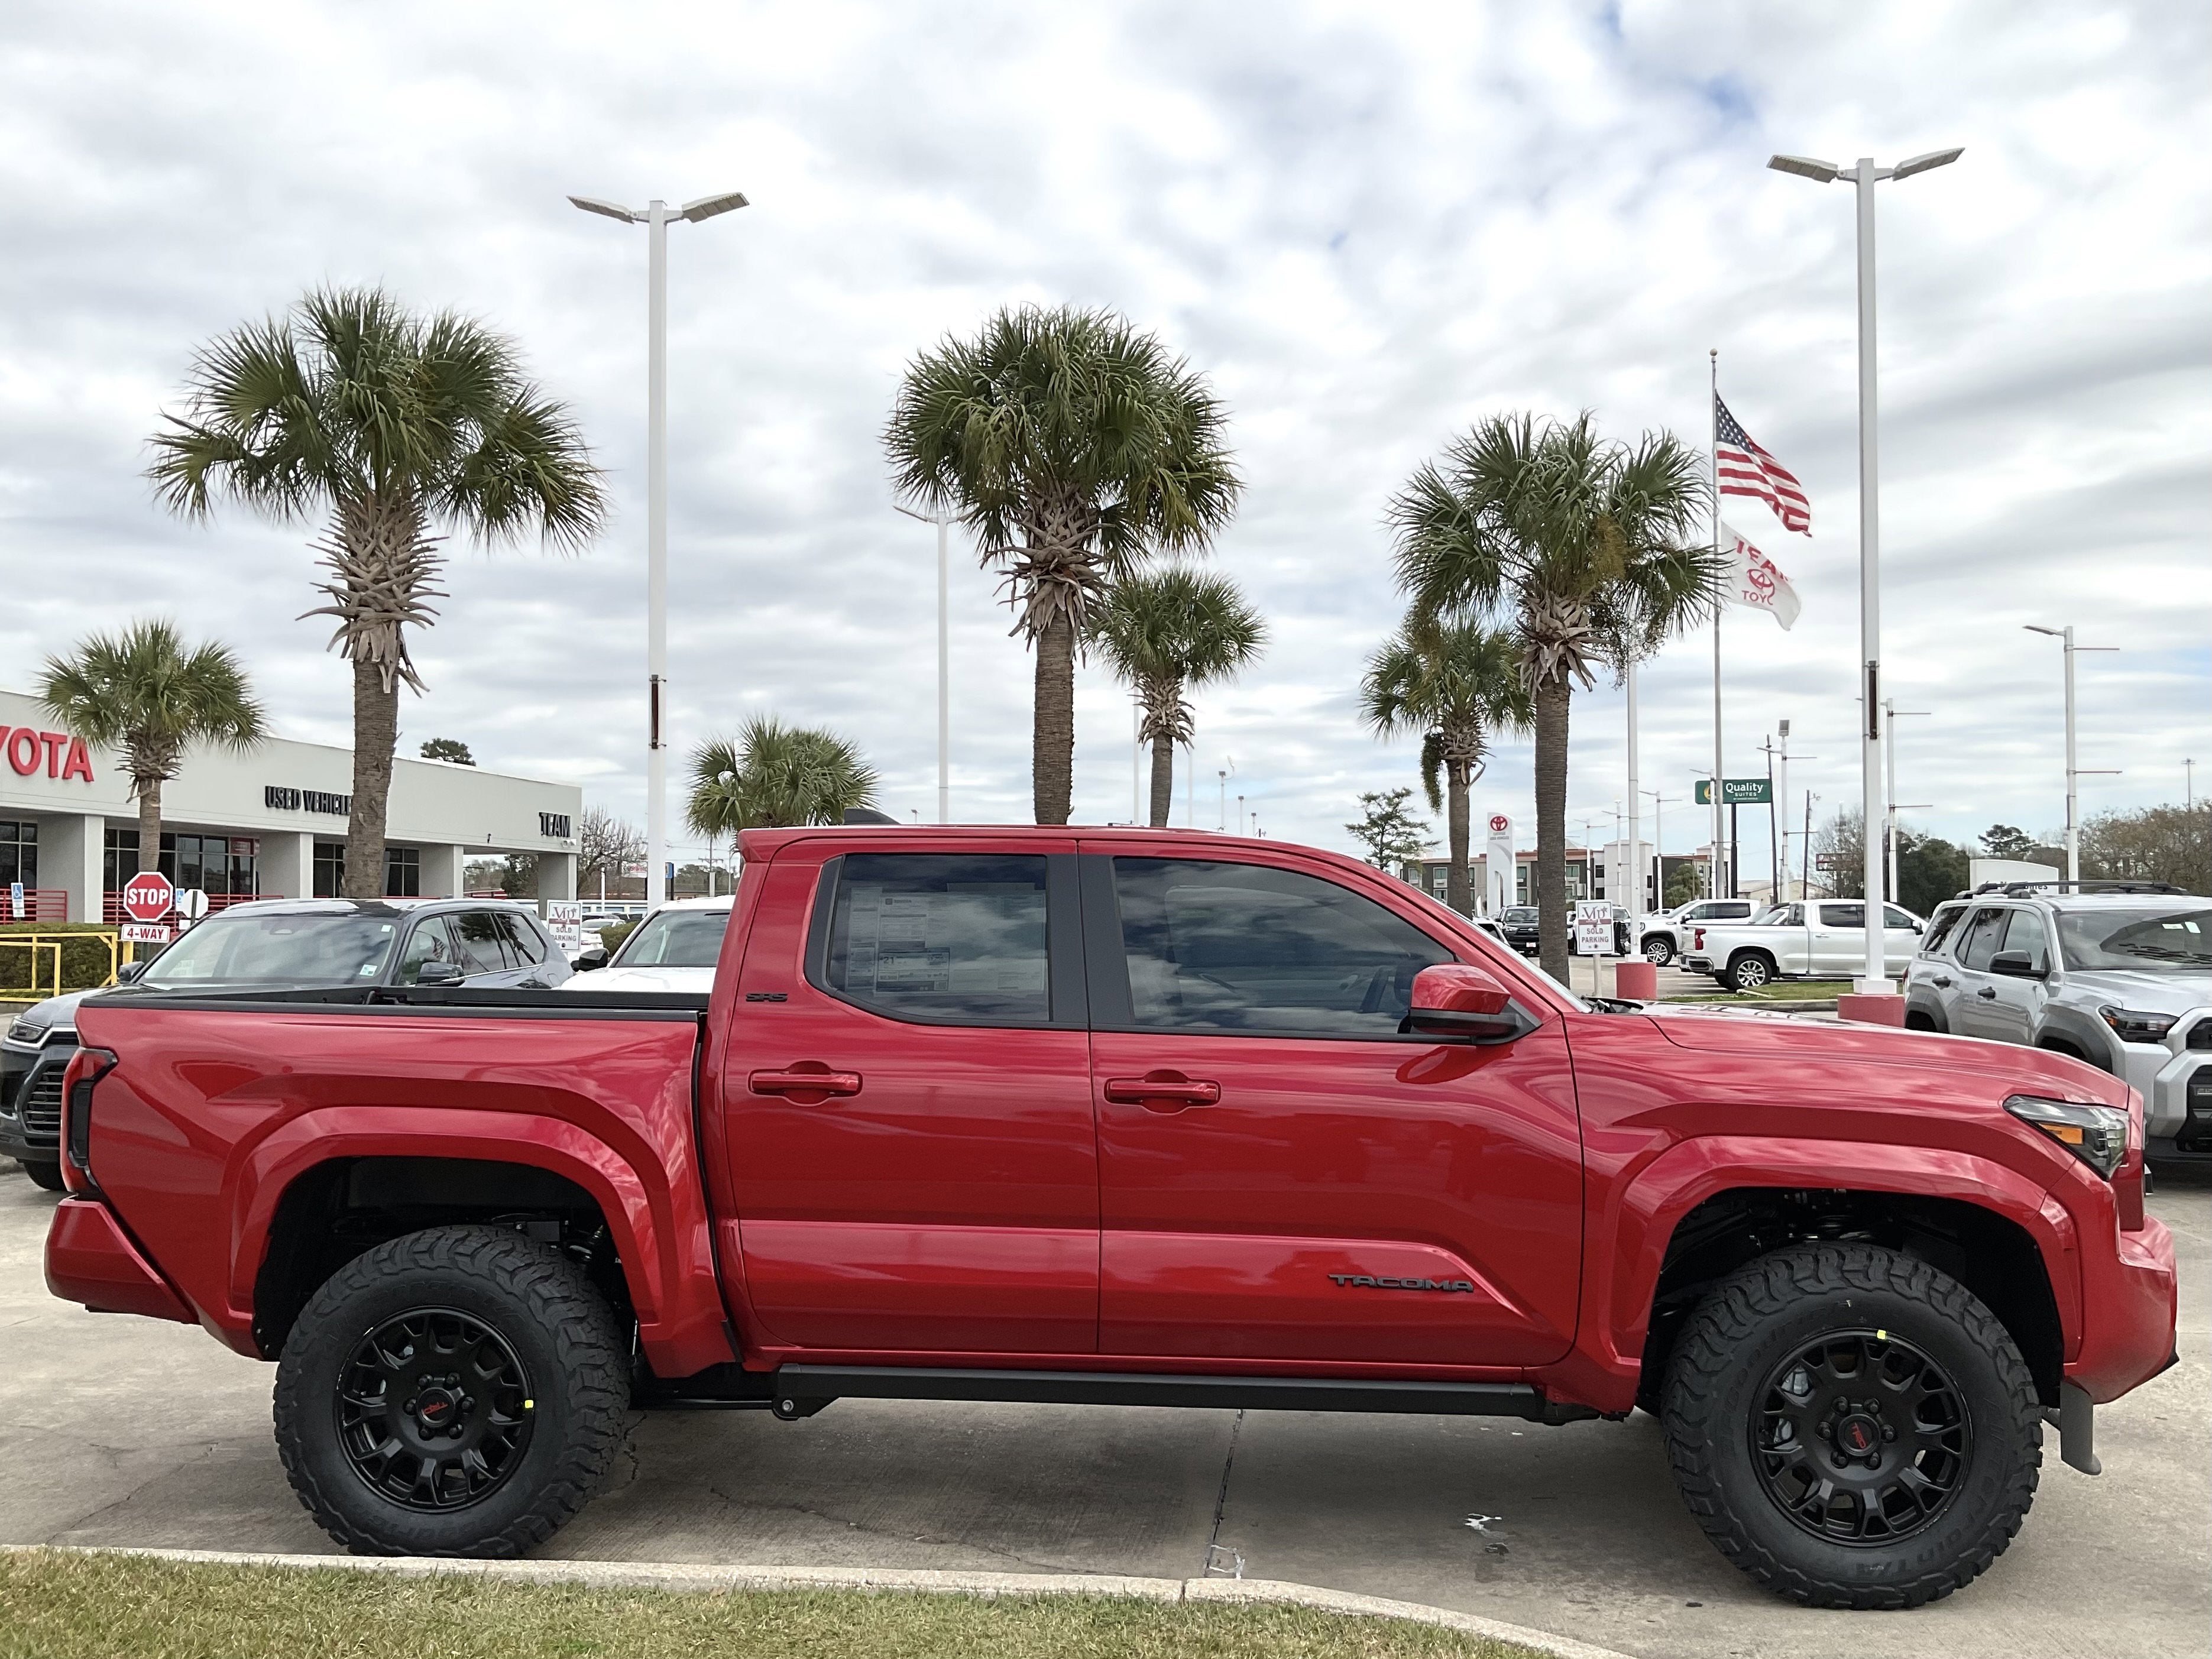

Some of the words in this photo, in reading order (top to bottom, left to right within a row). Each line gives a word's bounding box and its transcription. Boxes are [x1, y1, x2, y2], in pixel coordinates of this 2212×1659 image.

[1725, 782, 1763, 793] Quality
[265, 785, 302, 811] USED
[539, 812, 571, 838] TEAM
[128, 887, 169, 905] STOP
[127, 928, 164, 939] 4-WAY
[1327, 1274, 1475, 1293] TACOMA
